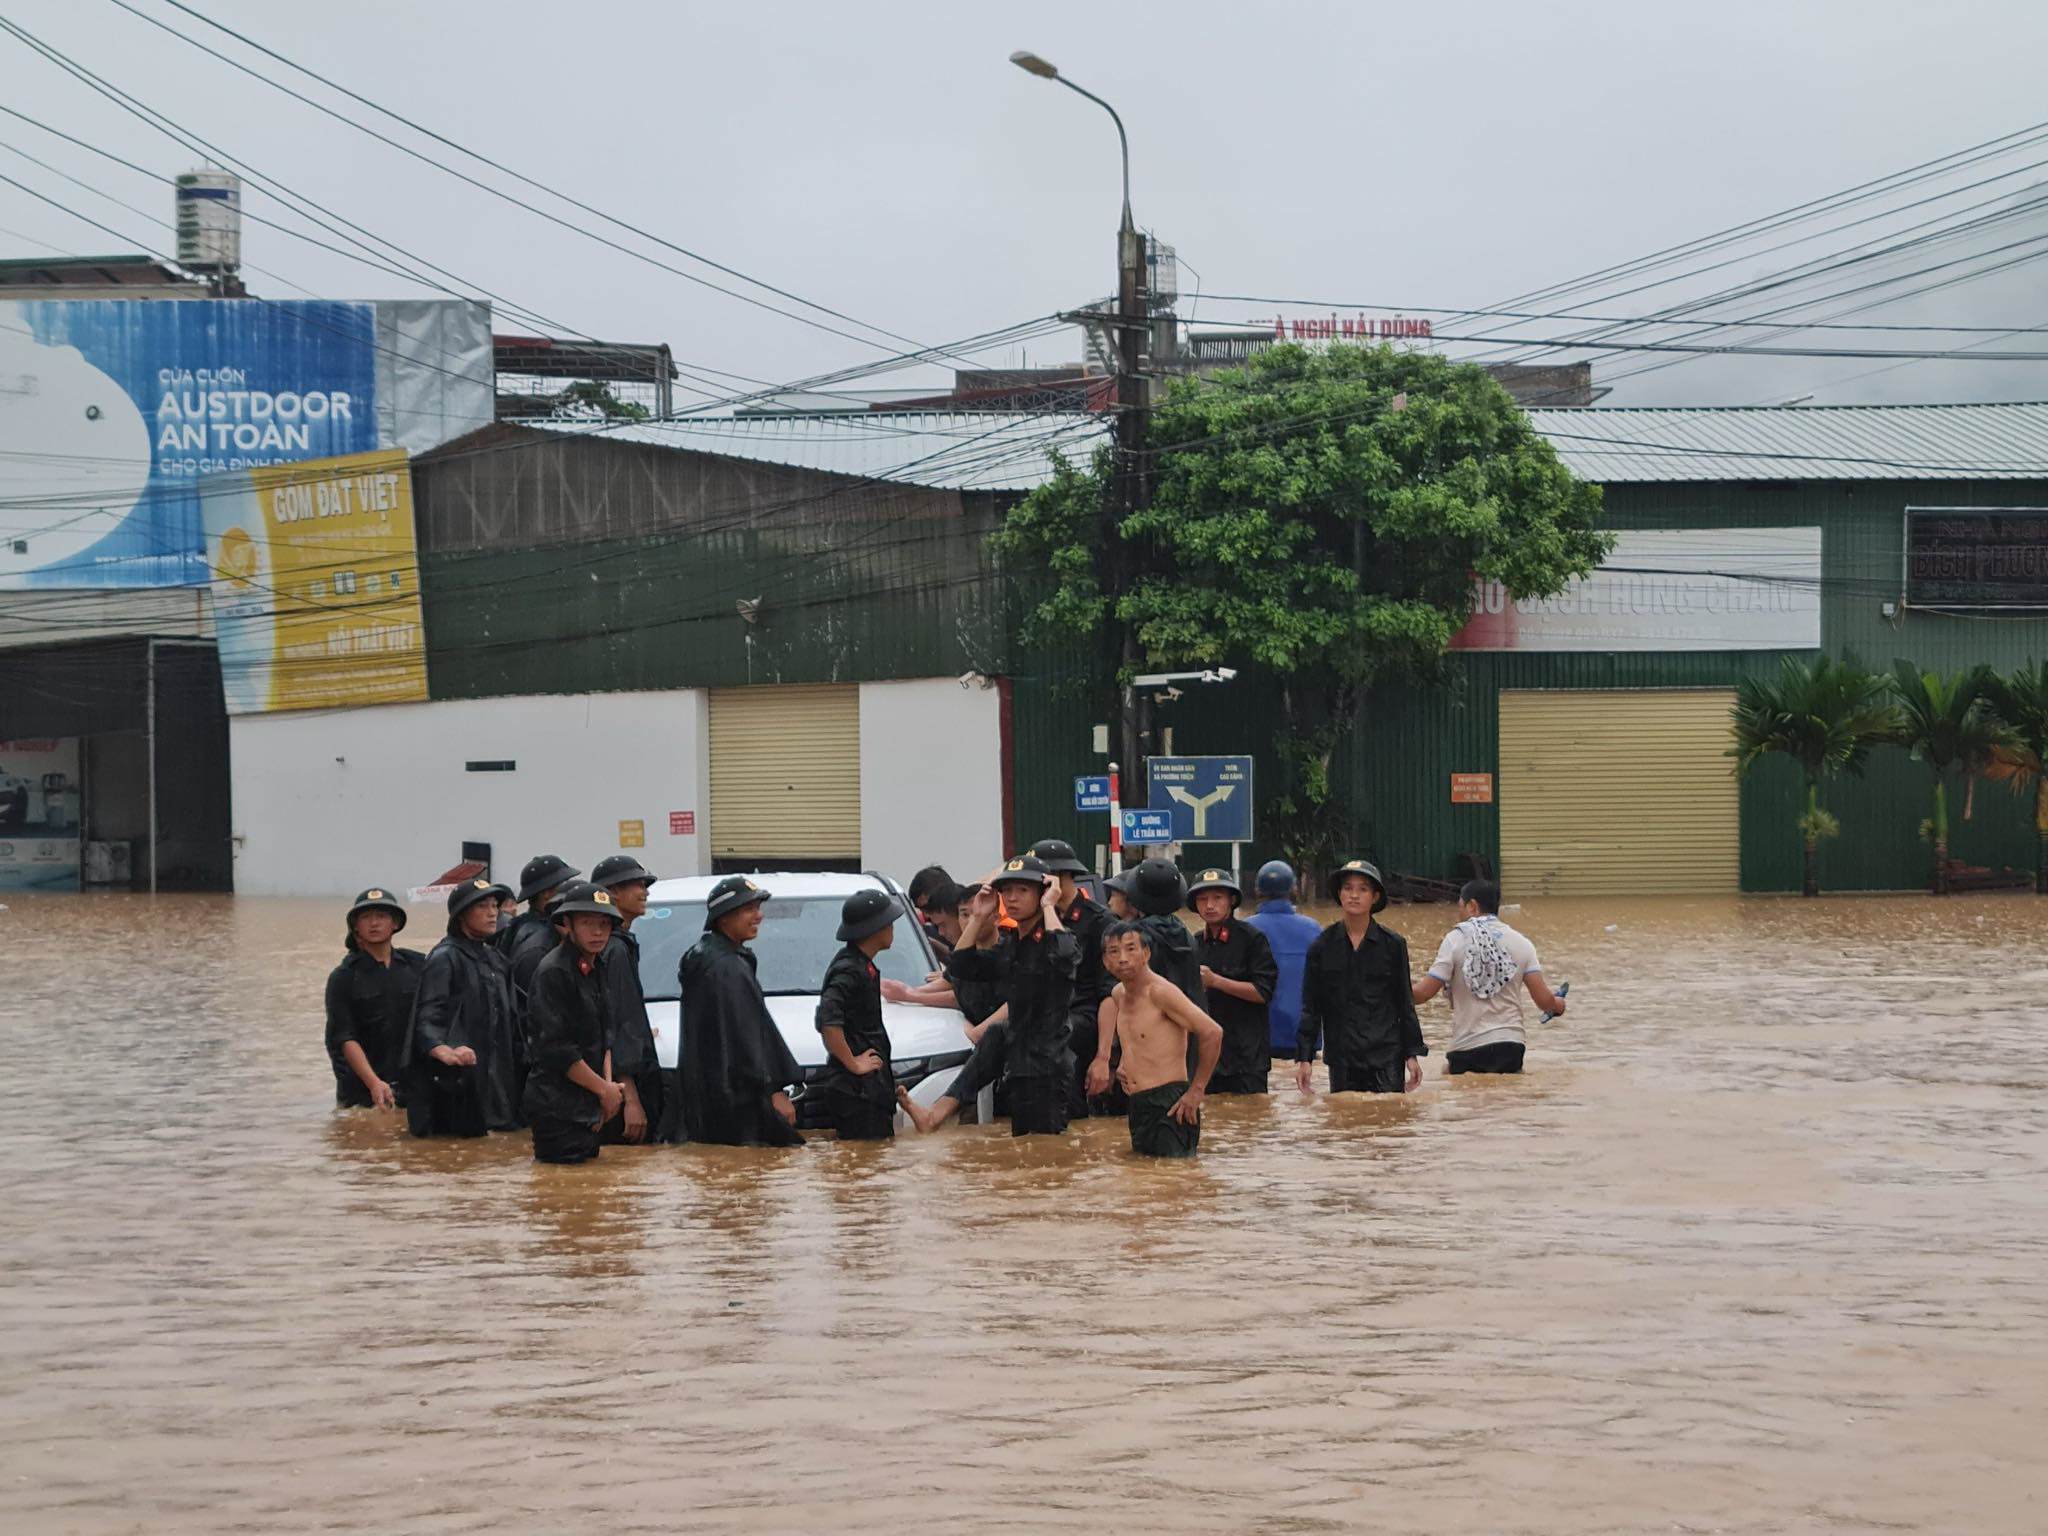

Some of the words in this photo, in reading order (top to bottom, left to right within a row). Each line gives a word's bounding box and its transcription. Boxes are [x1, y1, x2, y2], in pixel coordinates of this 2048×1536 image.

[157, 391, 353, 420] AUSTDOOR
[157, 423, 208, 451] AN
[211, 418, 310, 451] TOÀN
[159, 457, 199, 474] CHO
[200, 457, 228, 473] GIA
[356, 468, 400, 522] VIỆT
